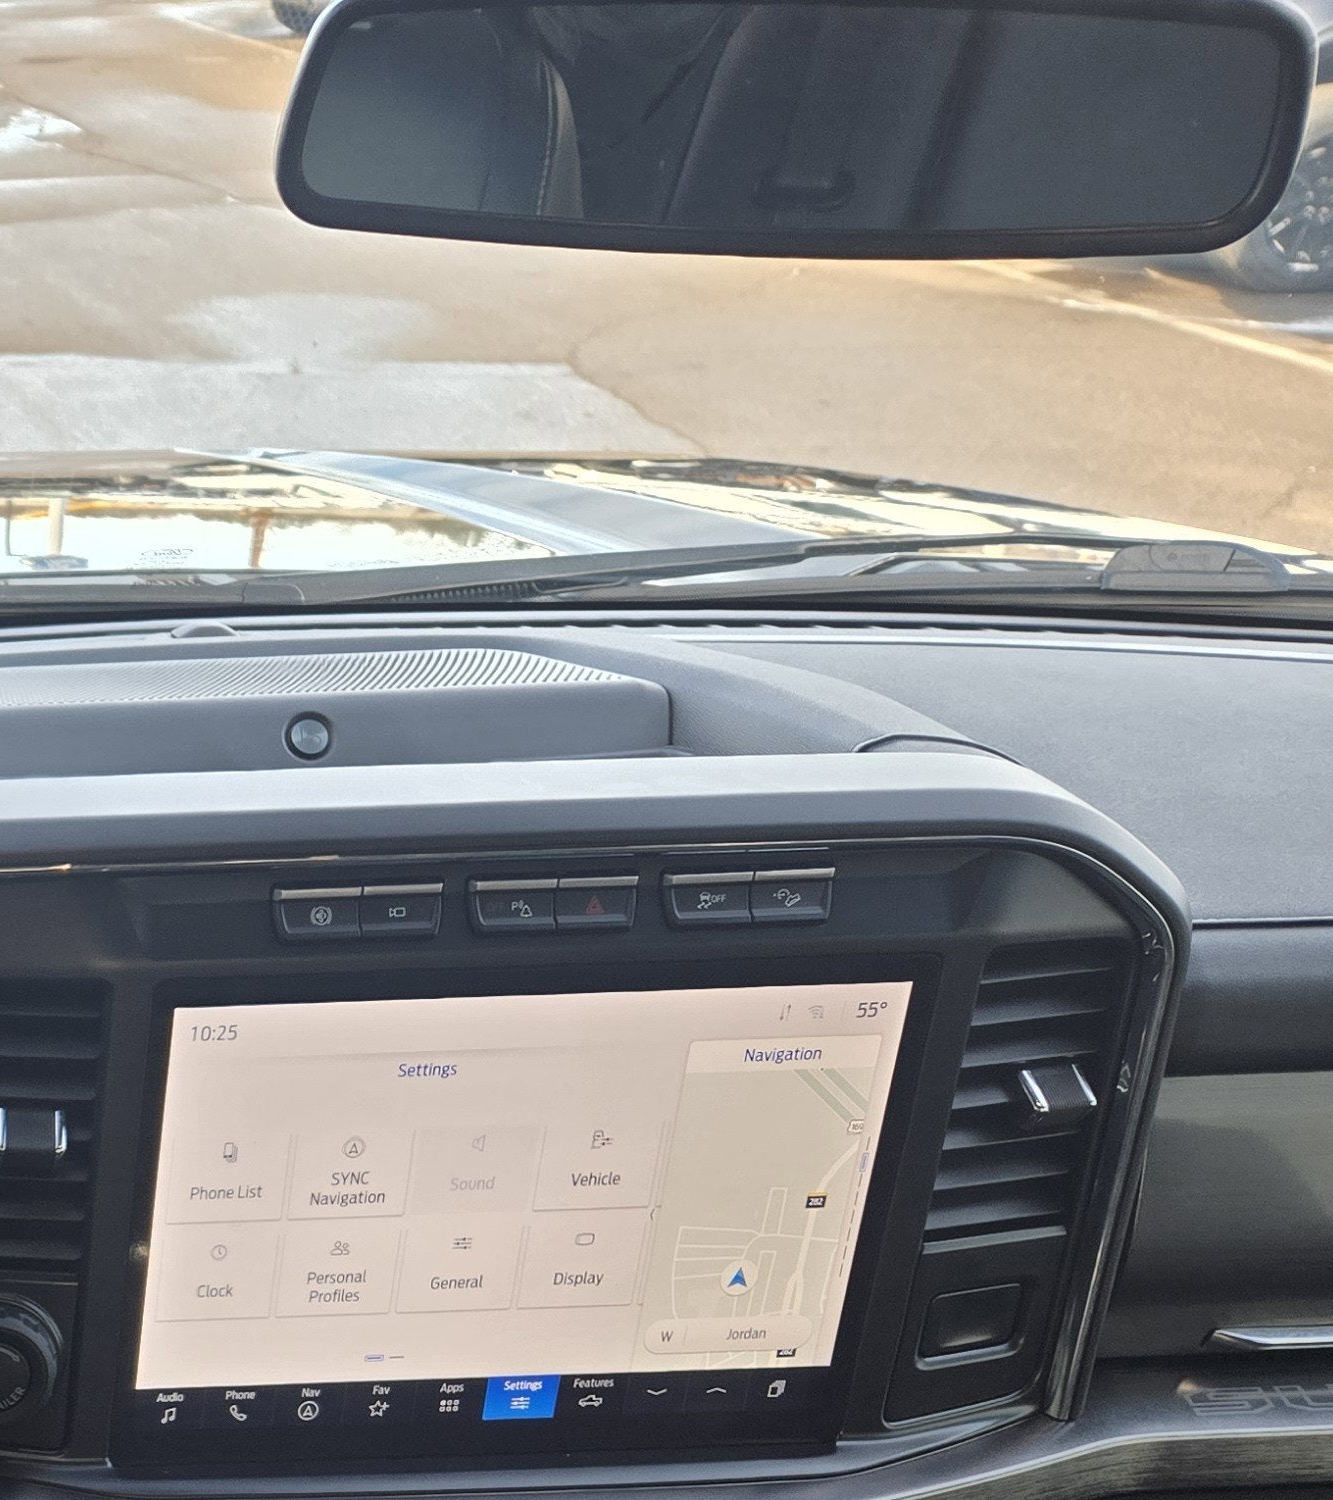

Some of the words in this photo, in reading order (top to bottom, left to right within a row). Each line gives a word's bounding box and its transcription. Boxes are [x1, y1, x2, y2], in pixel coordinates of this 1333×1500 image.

[711, 893, 728, 903] OFF
[190, 1024, 238, 1042] 10:25
[744, 1047, 822, 1063] Navigation
[397, 1063, 458, 1078] Settings
[332, 1171, 369, 1186] SYNC
[450, 1176, 495, 1191] Sound
[571, 1171, 621, 1187] Vehicle
[190, 1186, 234, 1201] Phone
[238, 1185, 262, 1200] List
[309, 1191, 385, 1208] Navigation
[307, 1269, 367, 1285] Personal
[430, 1275, 483, 1290] General
[553, 1271, 604, 1287] Display
[197, 1284, 233, 1299] Clock
[309, 1288, 360, 1303] Profiles
[661, 1331, 674, 1342] W
[726, 1327, 767, 1341] Jordan
[372, 1384, 391, 1396] Fav
[440, 1382, 464, 1395] Apps
[503, 1379, 543, 1392] Settings
[573, 1377, 614, 1389] Features
[157, 1391, 183, 1403] Audio
[225, 1388, 255, 1401] Phone
[301, 1386, 321, 1398] Nav
